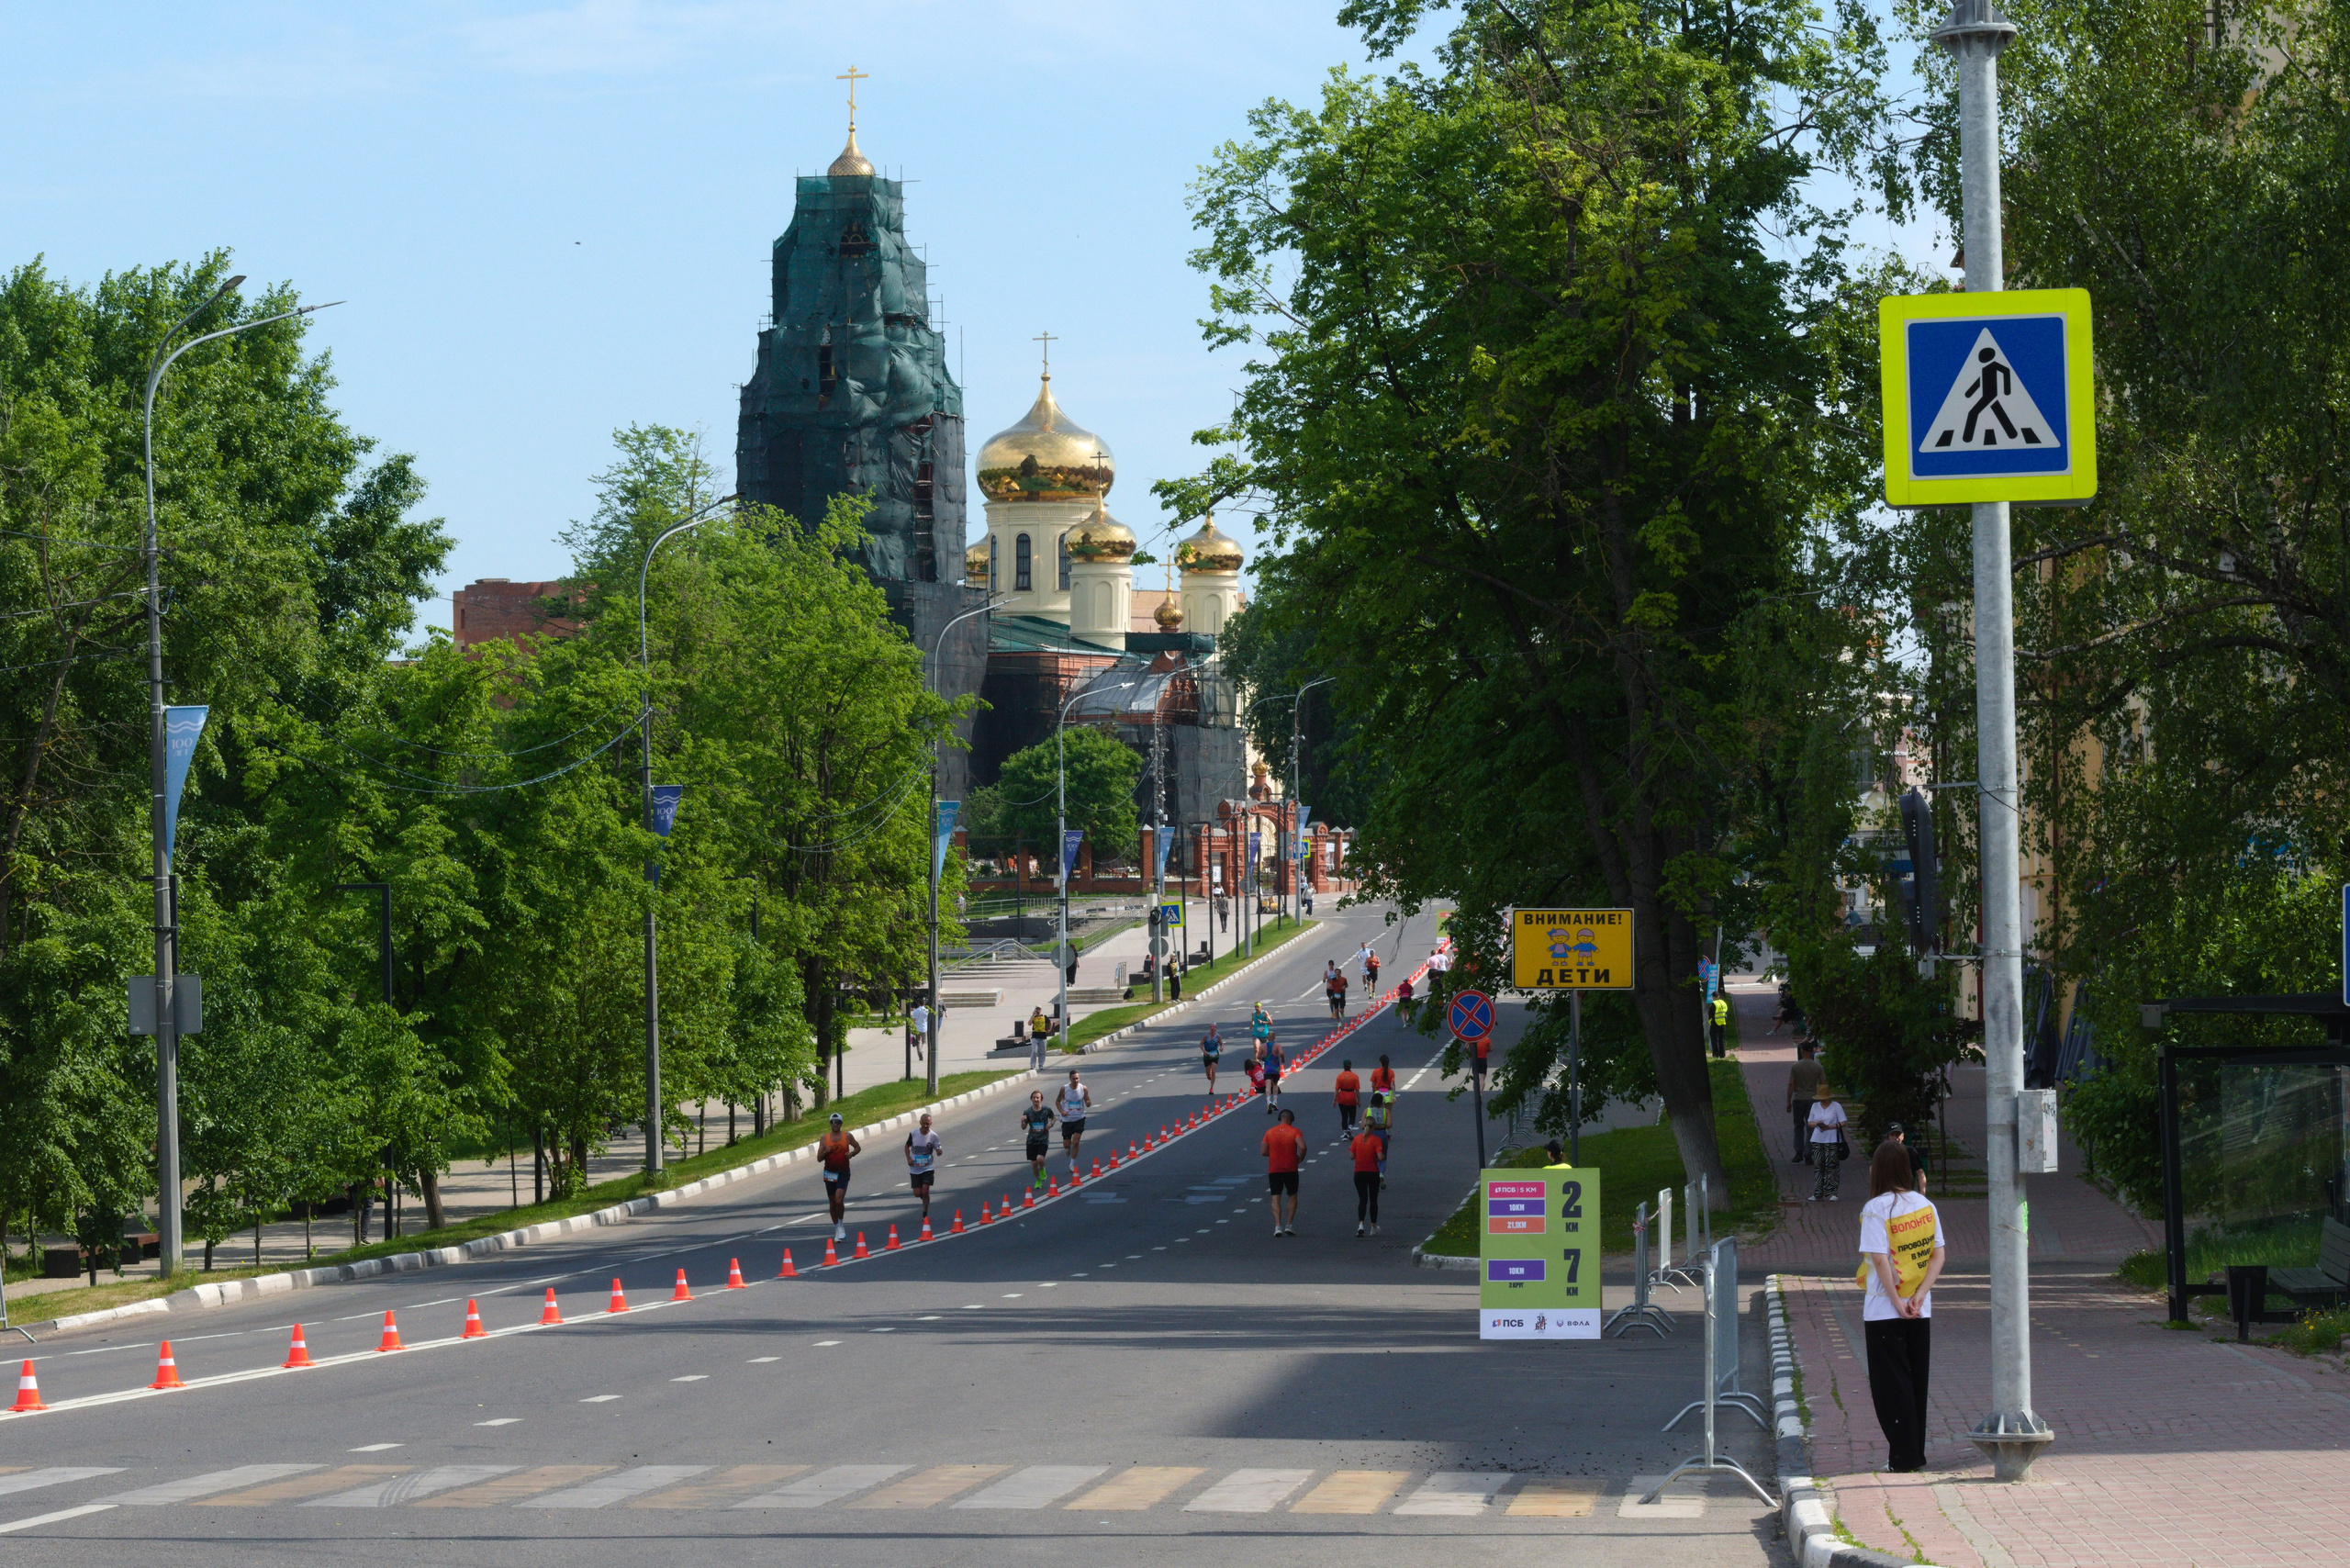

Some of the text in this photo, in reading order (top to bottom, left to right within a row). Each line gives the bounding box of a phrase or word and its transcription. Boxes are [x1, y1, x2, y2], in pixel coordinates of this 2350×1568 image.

[171, 737, 193, 749] 100
[656, 807, 673, 815] 100
[1524, 913, 1622, 924] ВНИМАНИЕ!
[1537, 969, 1609, 986] ДЕТИ
[1561, 1181, 1582, 1218] 2
[1565, 1222, 1578, 1232] КМ
[1563, 1249, 1581, 1282] 7
[1566, 1287, 1578, 1296] КМ
[1503, 1319, 1524, 1327] ПСБ
